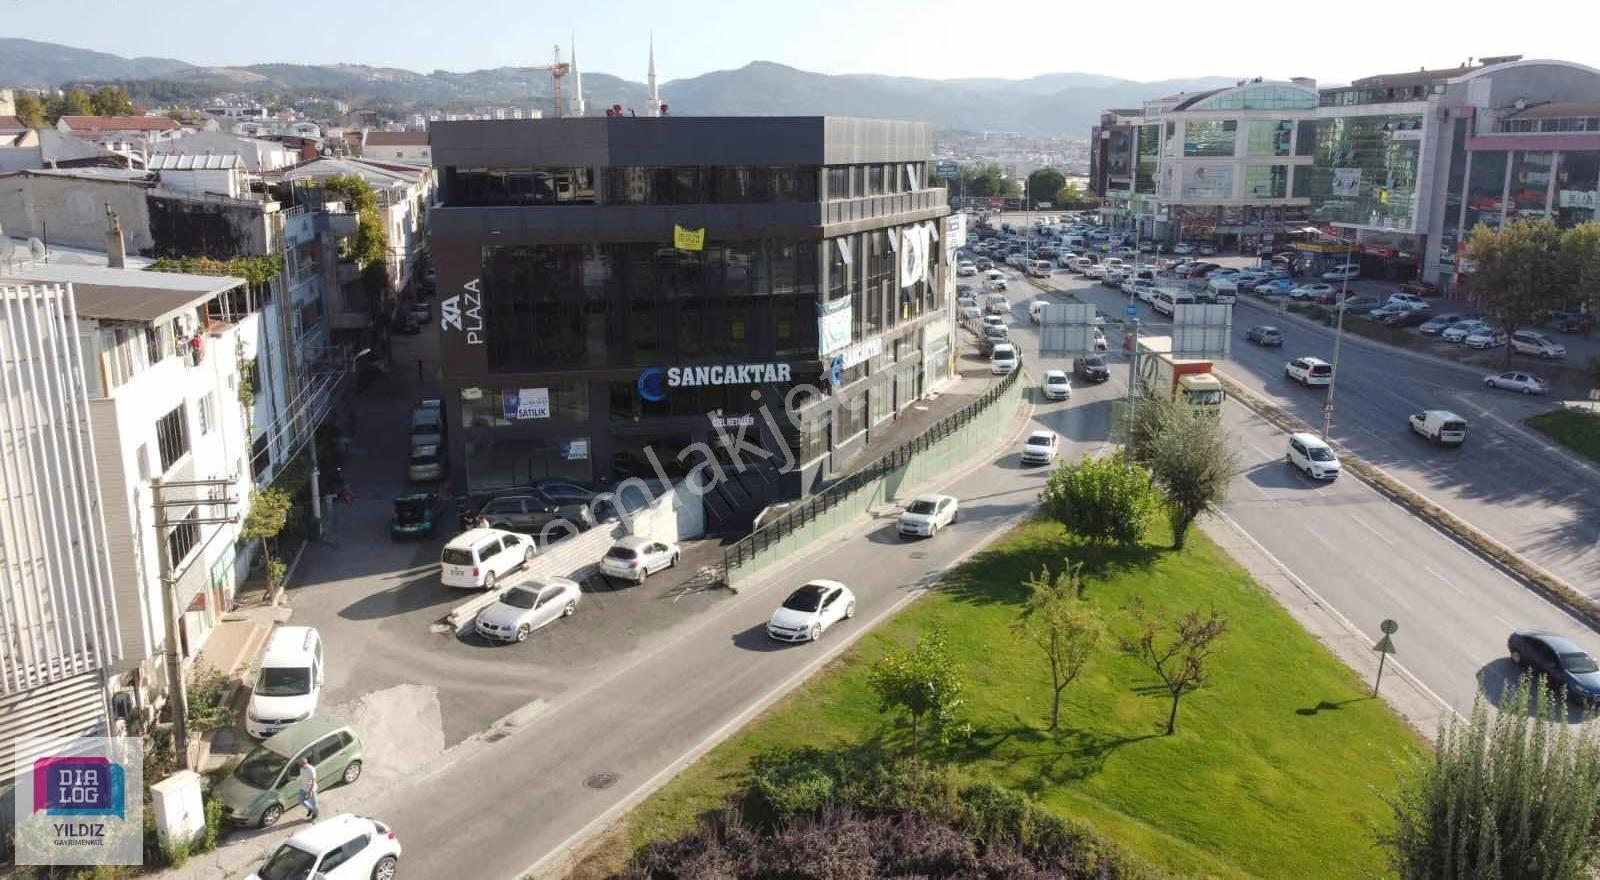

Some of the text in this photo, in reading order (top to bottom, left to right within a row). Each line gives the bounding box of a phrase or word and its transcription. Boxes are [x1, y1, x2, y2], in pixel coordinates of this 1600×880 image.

[464, 278, 483, 344] PLAZA
[667, 363, 792, 387] SANCAKTAR
[518, 407, 546, 417] SATILIK
